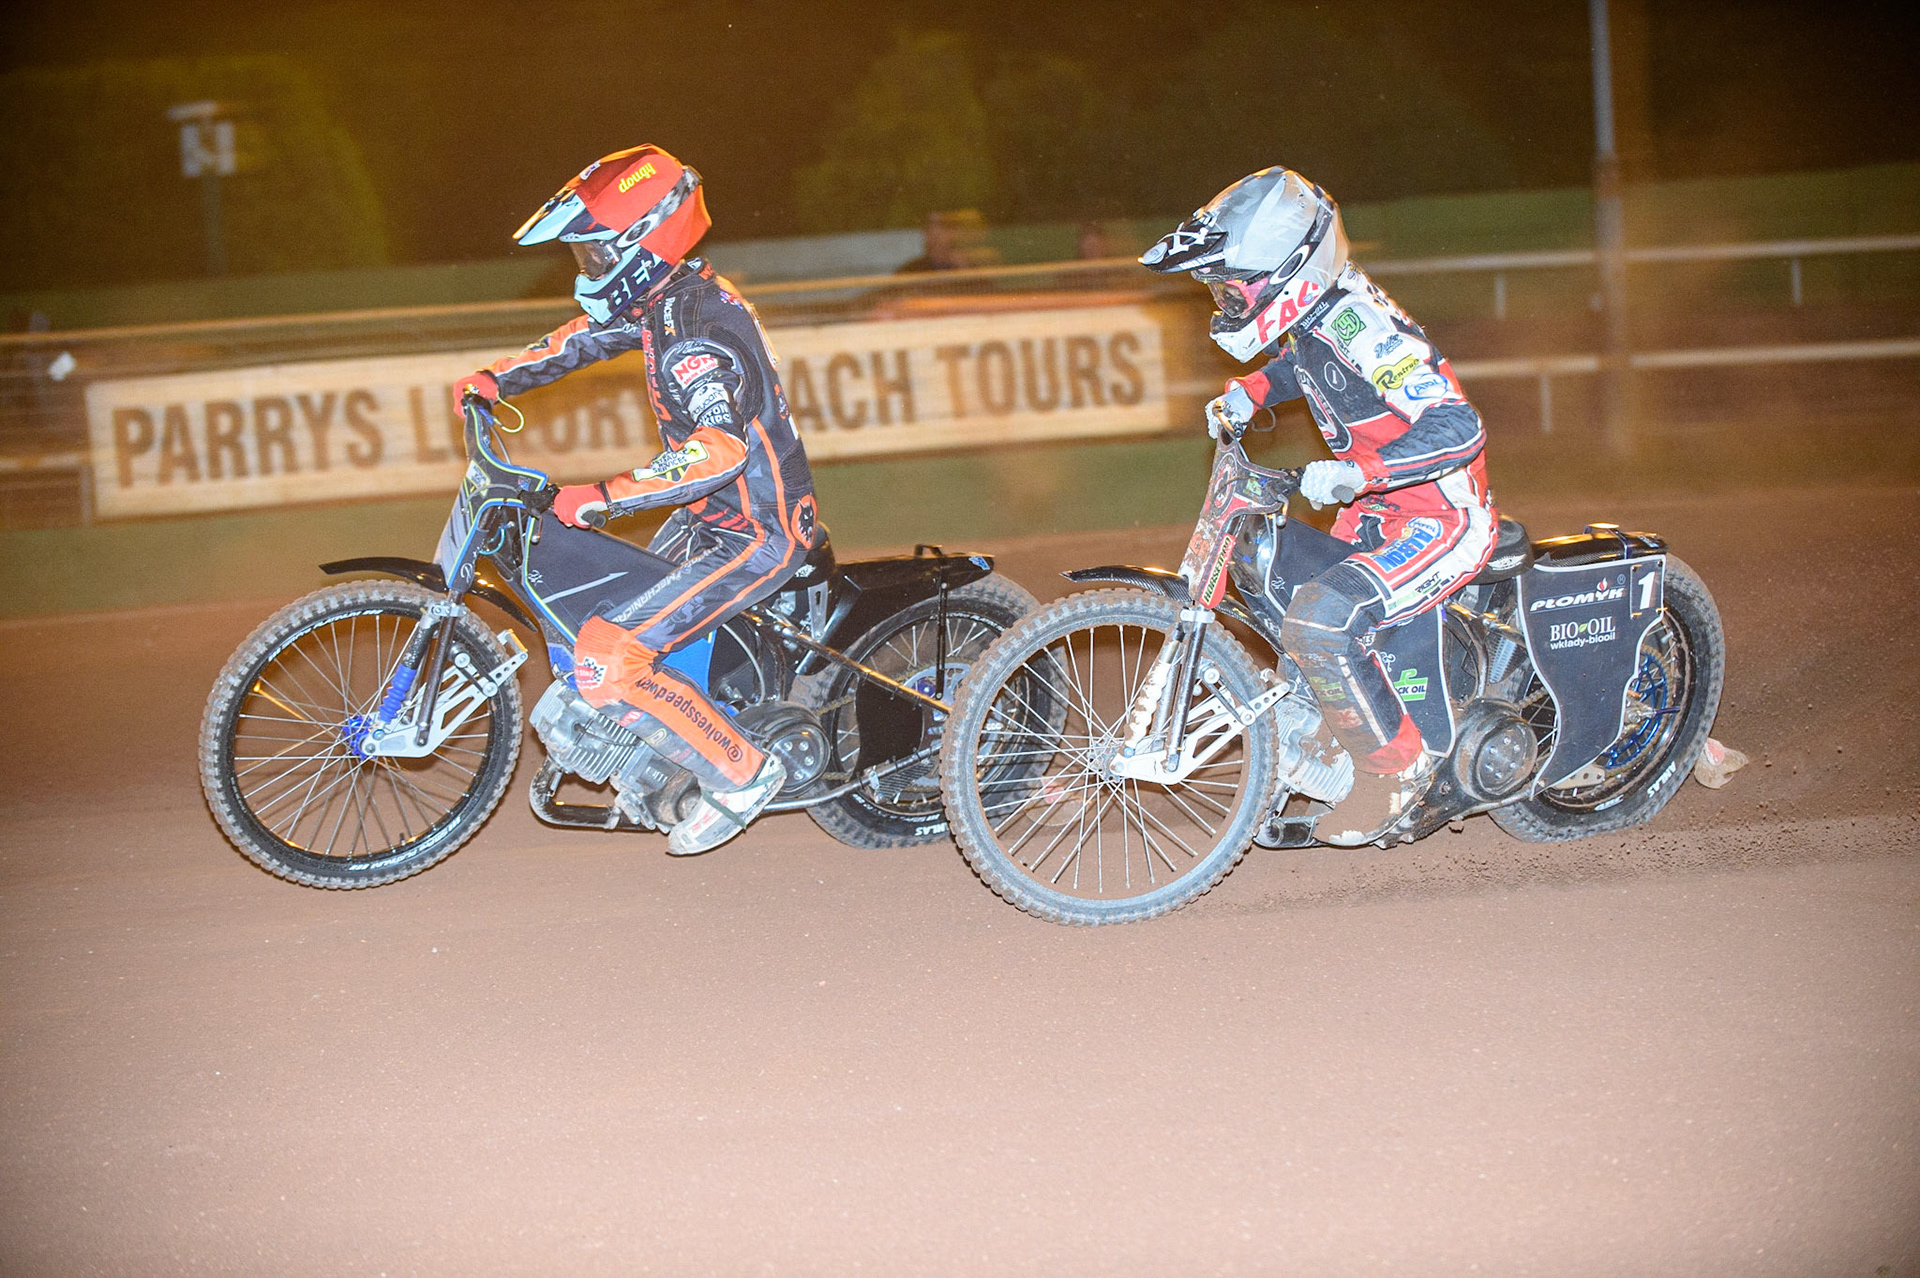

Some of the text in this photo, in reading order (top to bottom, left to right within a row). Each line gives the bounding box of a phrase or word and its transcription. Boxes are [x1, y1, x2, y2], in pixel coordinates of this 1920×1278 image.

[618, 162, 657, 194] dougy
[112, 388, 385, 490] PARRYS
[787, 347, 917, 432] ACH
[938, 329, 1146, 417] TOURS
[1638, 571, 1656, 610] 1
[1549, 615, 1616, 642] BIO OIL
[1411, 684, 1426, 694] OIL
[635, 675, 743, 763] @wolvesspeedway
